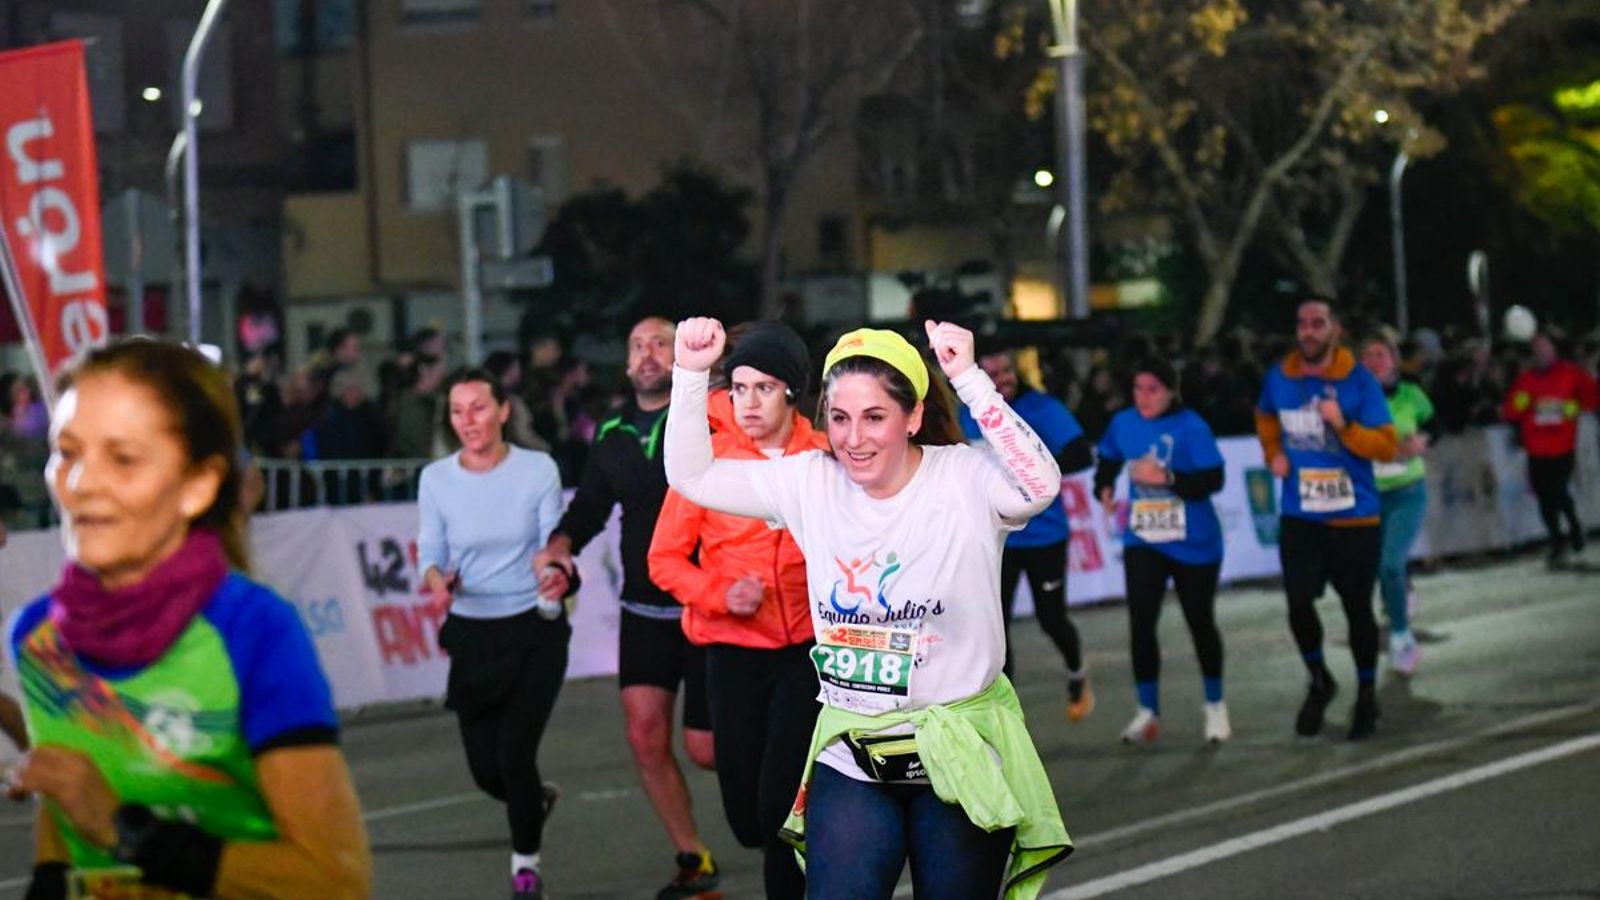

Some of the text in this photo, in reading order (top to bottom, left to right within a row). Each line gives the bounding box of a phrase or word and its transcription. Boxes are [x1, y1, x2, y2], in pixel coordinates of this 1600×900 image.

[6, 114, 109, 368] erón
[307, 596, 345, 637] sa
[818, 600, 870, 626] Equipo
[817, 645, 902, 686] 2918
